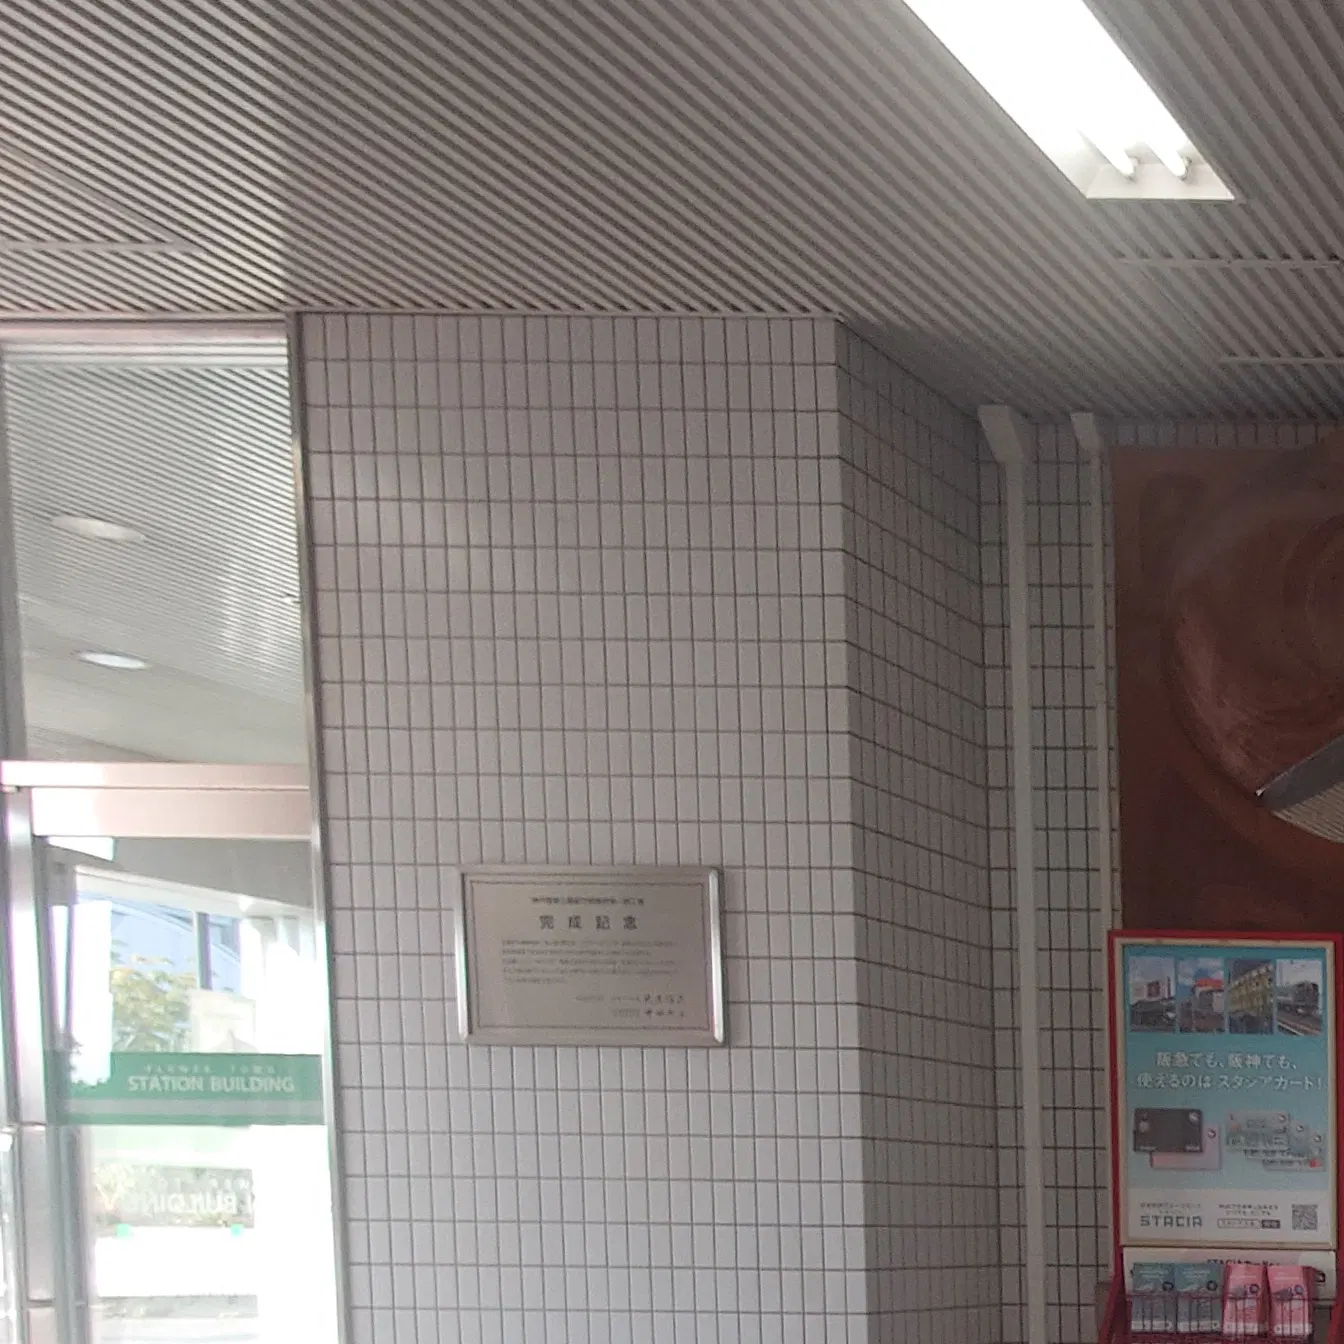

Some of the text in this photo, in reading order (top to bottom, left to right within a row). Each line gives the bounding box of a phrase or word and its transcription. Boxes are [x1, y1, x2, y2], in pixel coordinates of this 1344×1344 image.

[538, 914, 637, 930] 完成記念
[128, 1075, 295, 1093] STATION BUILDING
[1140, 1215, 1202, 1228] STACIA
